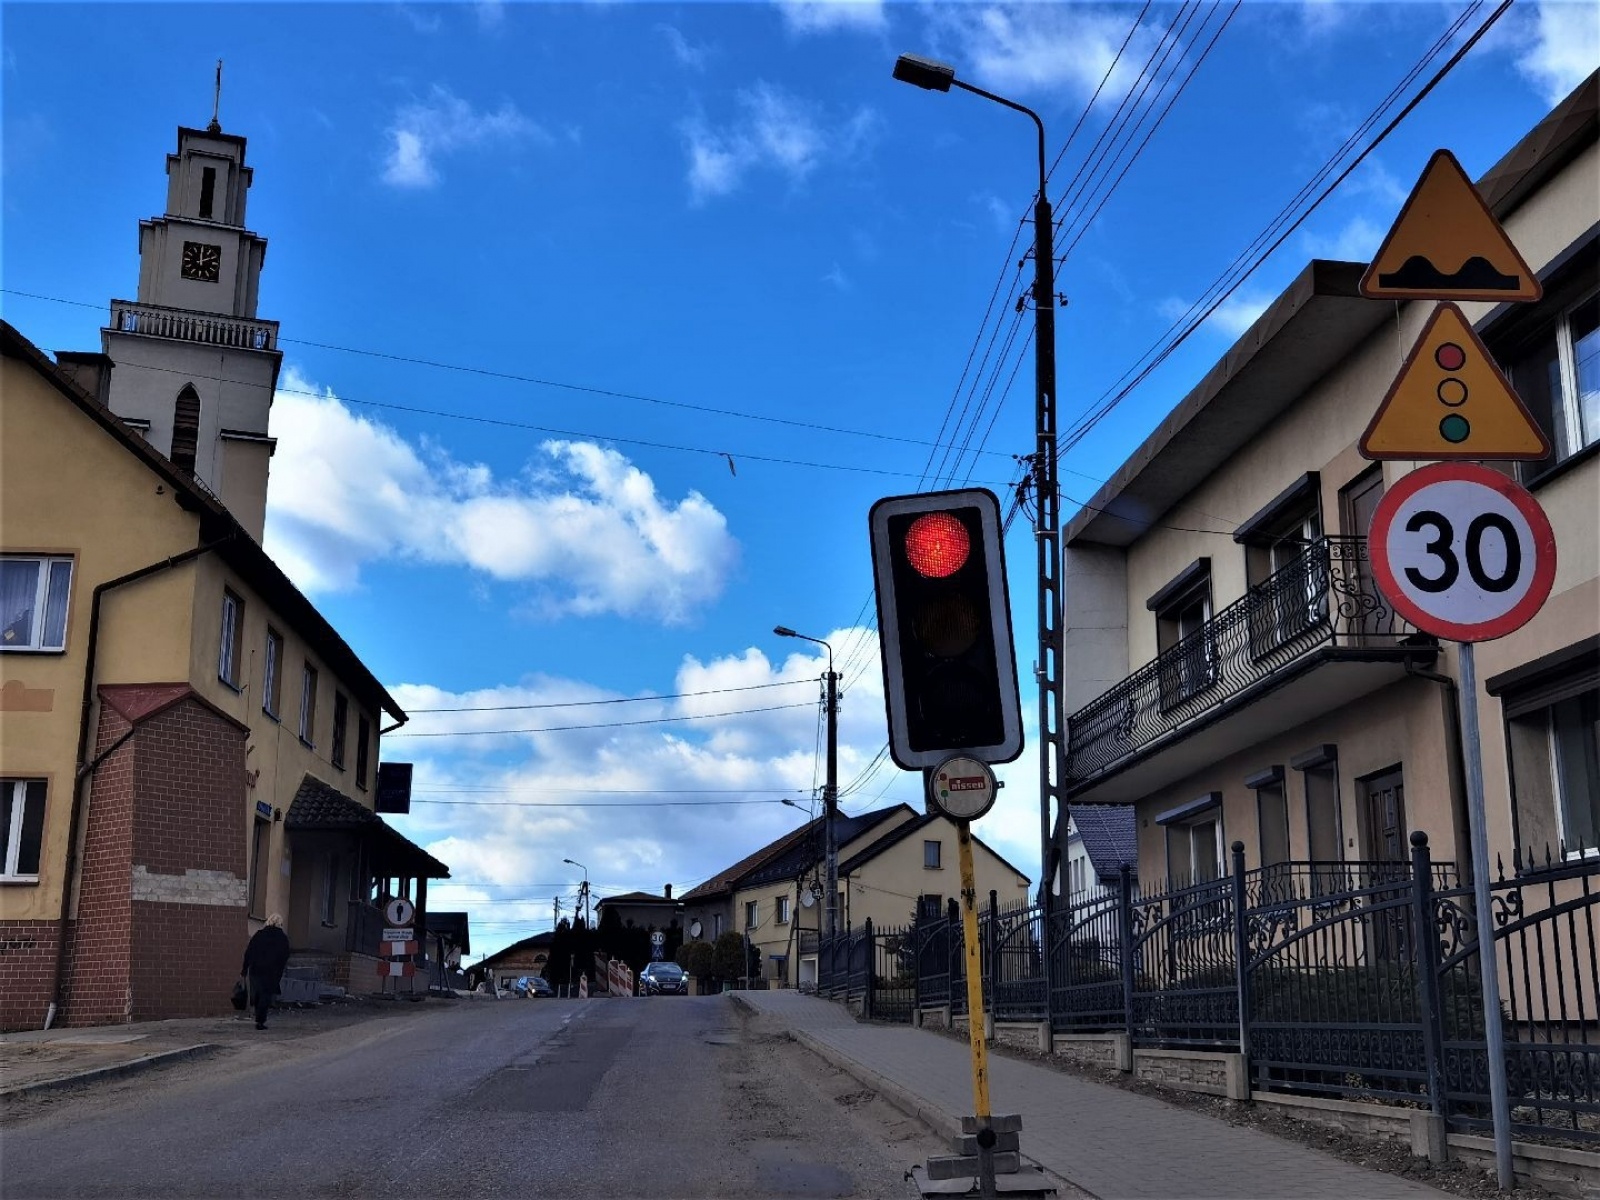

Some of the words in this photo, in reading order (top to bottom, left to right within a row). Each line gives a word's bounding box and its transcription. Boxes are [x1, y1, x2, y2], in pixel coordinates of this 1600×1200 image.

[1404, 510, 1521, 592] 30
[951, 779, 984, 790] nissen
[652, 934, 664, 942] 30
